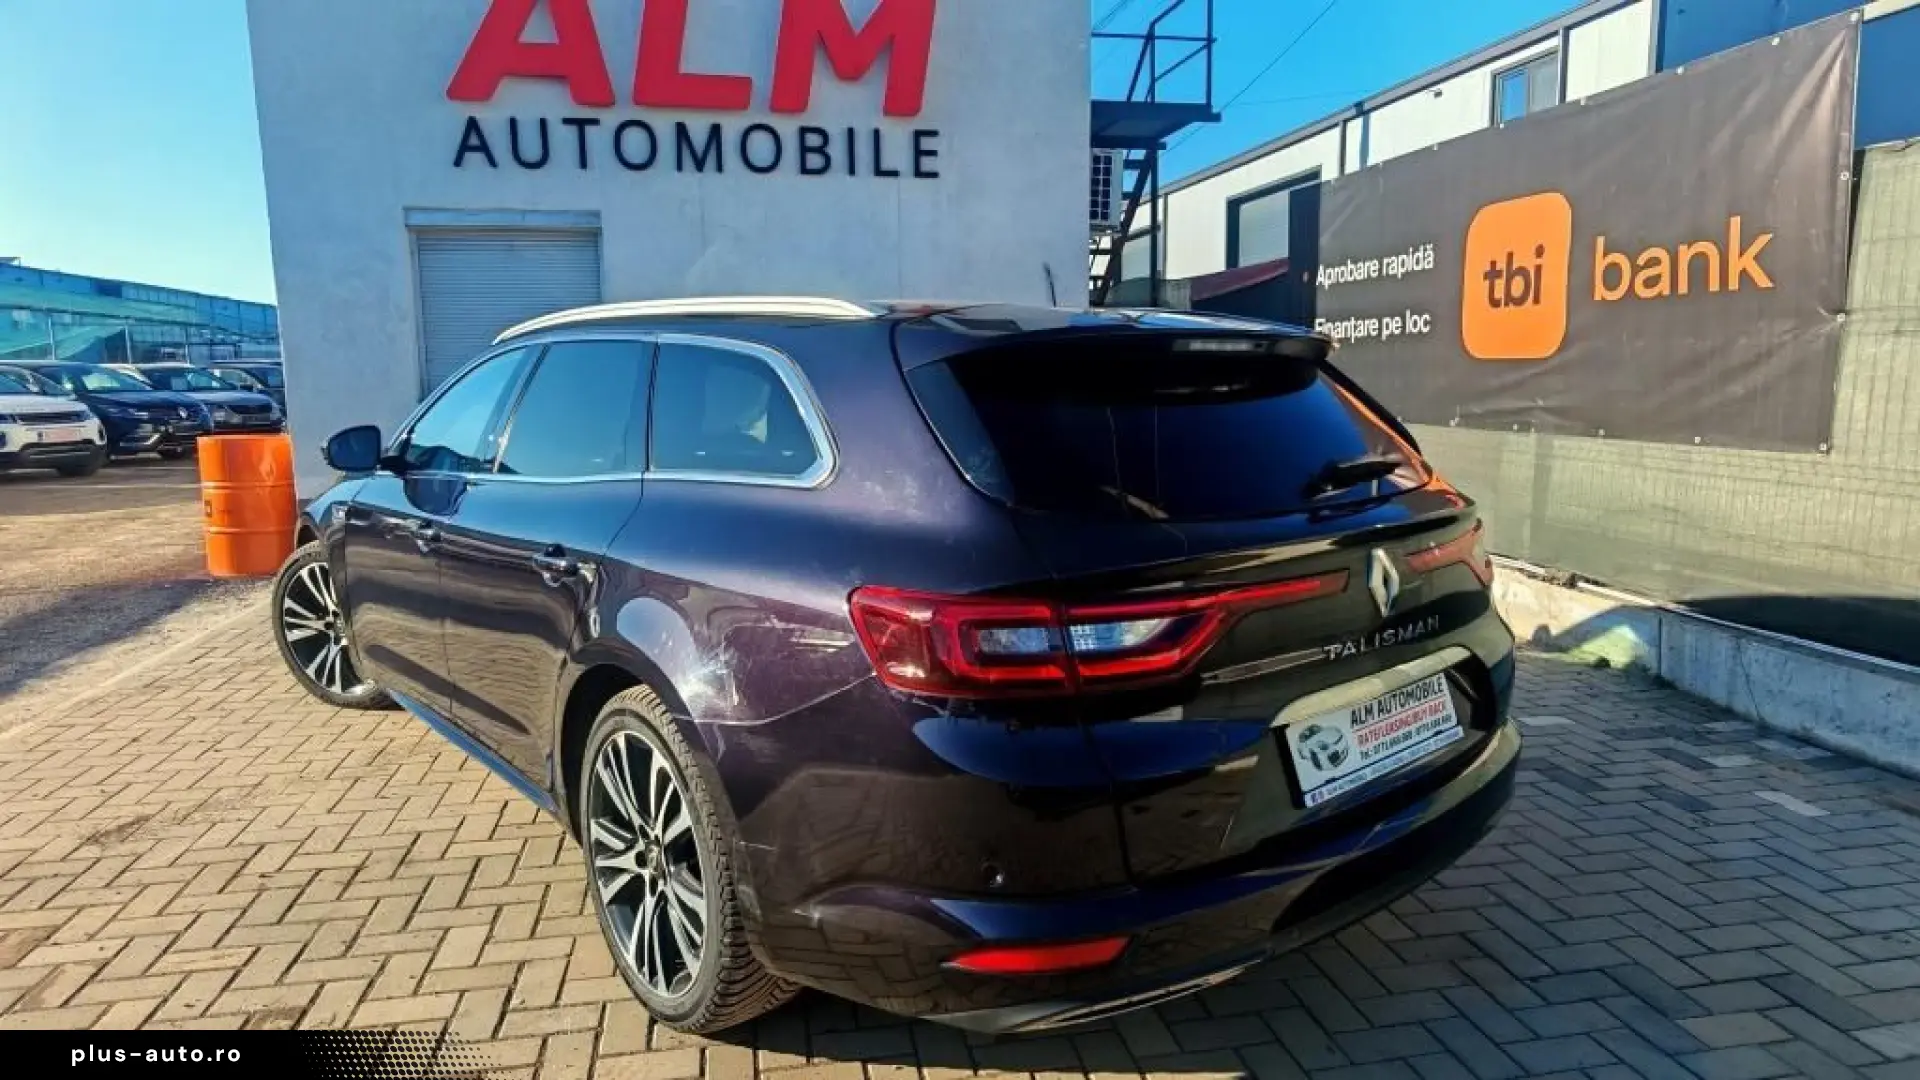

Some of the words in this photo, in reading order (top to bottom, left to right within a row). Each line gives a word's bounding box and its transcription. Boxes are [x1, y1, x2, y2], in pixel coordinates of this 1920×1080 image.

[446, 0, 937, 116] ALM
[453, 115, 940, 179] AUTOMOBILE
[1316, 258, 1379, 290] Aprobare
[1383, 243, 1434, 279] rapidă
[1483, 245, 1545, 309] tbi
[1593, 215, 1775, 301] bank
[1382, 316, 1402, 340] pe
[1406, 308, 1431, 334] loc
[1323, 614, 1440, 660] TALISMAN
[1351, 703, 1375, 728] ALM
[1377, 675, 1444, 718] AUTOMOBILE
